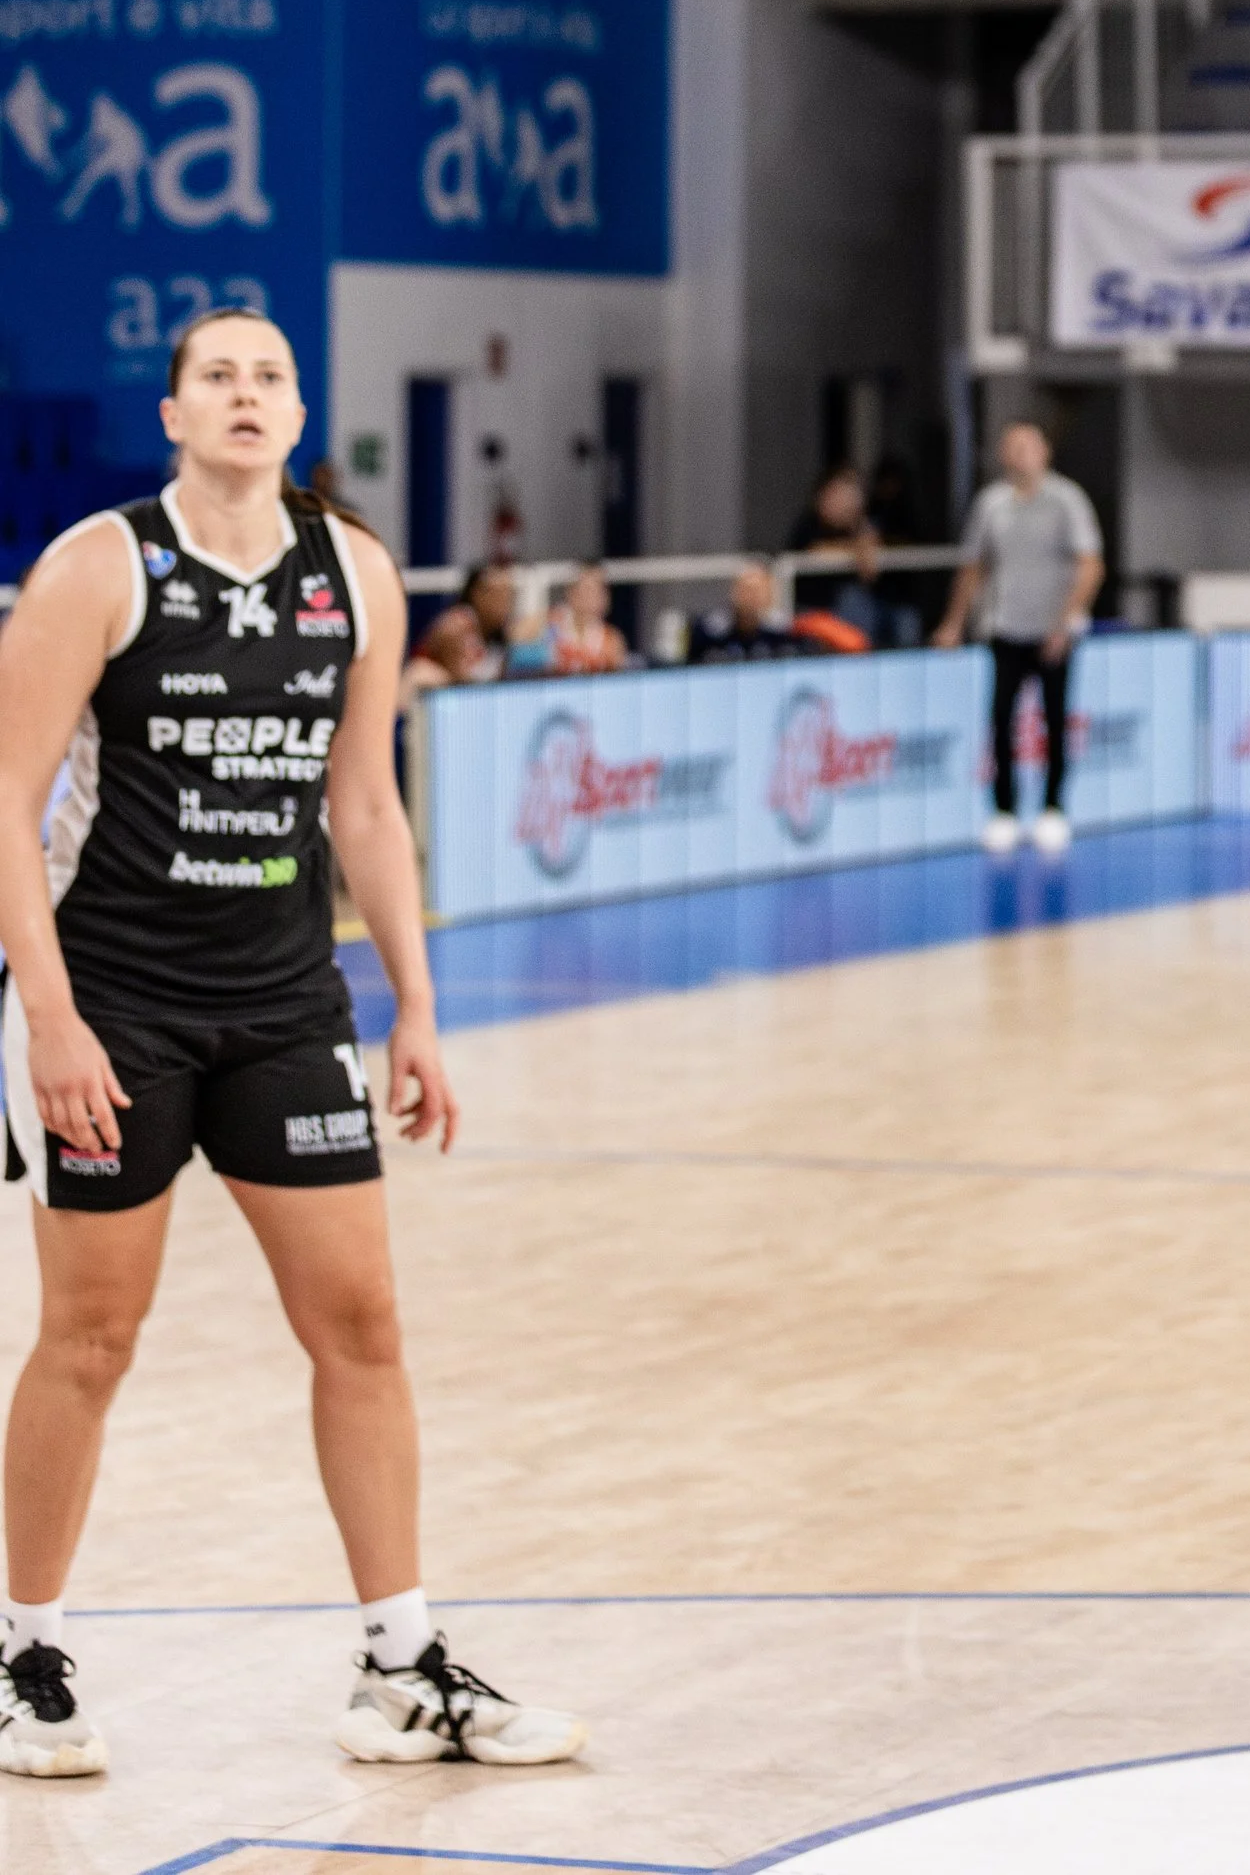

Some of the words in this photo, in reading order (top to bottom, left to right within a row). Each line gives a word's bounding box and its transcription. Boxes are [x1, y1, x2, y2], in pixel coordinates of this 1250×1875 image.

[218, 583, 278, 638] 14
[147, 715, 336, 757] PEOPLE
[332, 1043, 367, 1102] 1
